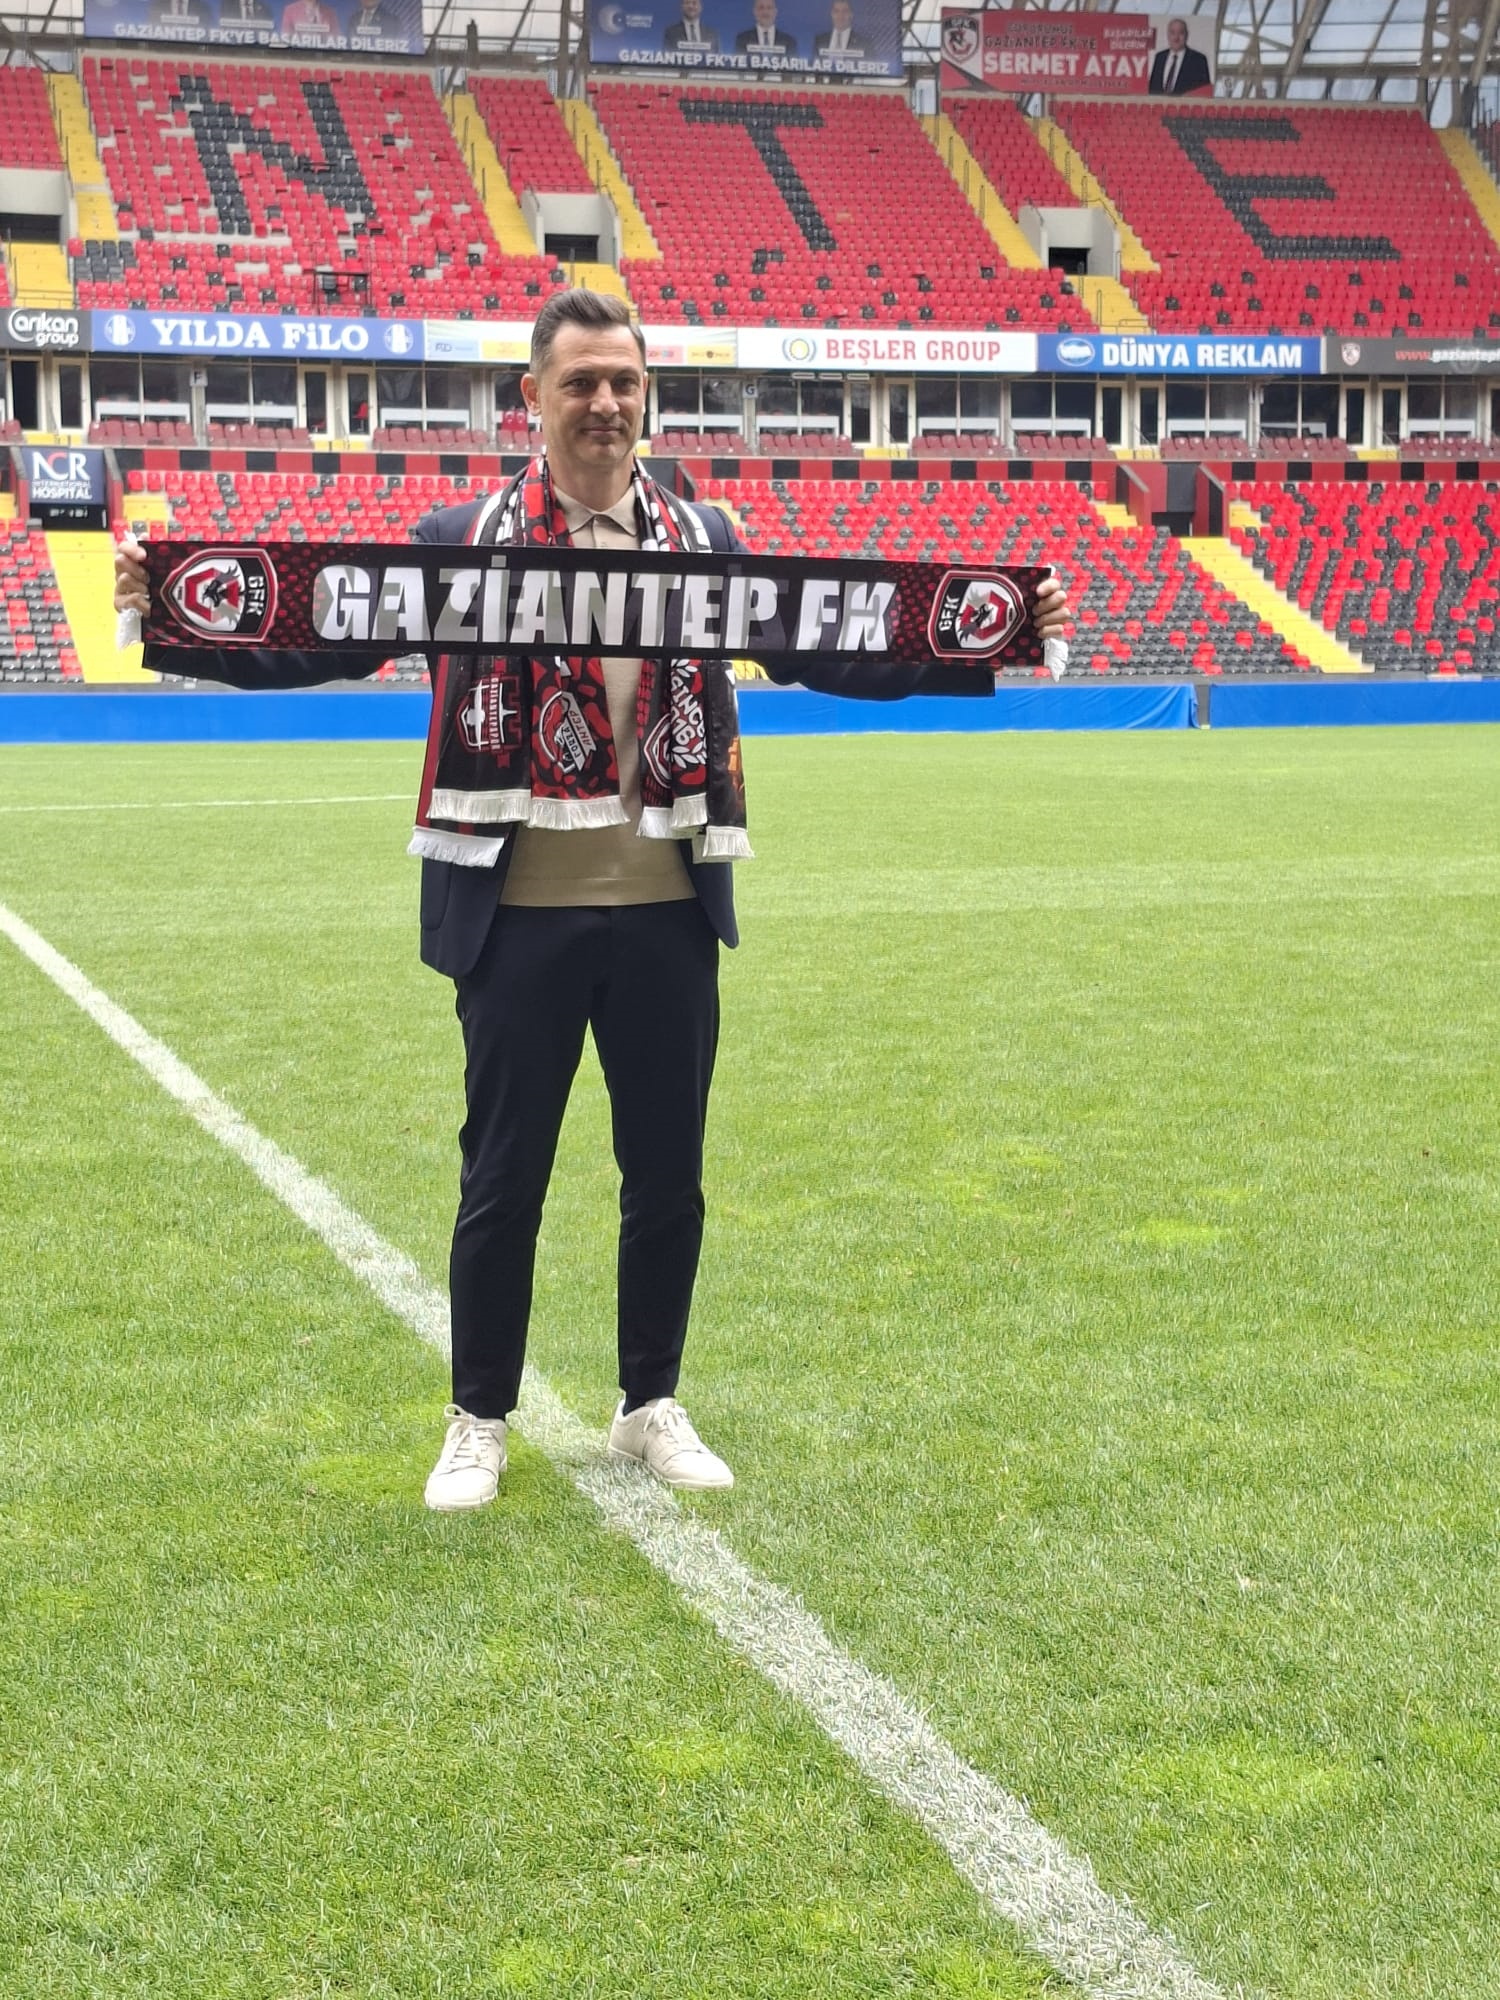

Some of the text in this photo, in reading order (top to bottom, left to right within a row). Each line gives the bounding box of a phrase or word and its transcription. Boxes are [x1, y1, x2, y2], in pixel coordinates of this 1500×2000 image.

[983, 51, 1148, 78] SERMET ATAY
[36, 332, 79, 348] group
[151, 318, 271, 348] YILDA
[826, 338, 1001, 365] BEŞLER GROUP
[1103, 337, 1190, 367] DÜNYA
[1197, 343, 1302, 368] REKLAM
[32, 452, 90, 481] NCR
[32, 487, 93, 500] HOSPITAL
[246, 575, 264, 616] GFK
[312, 555, 898, 653] GAZİANTEP FK
[938, 593, 960, 632] GFK
